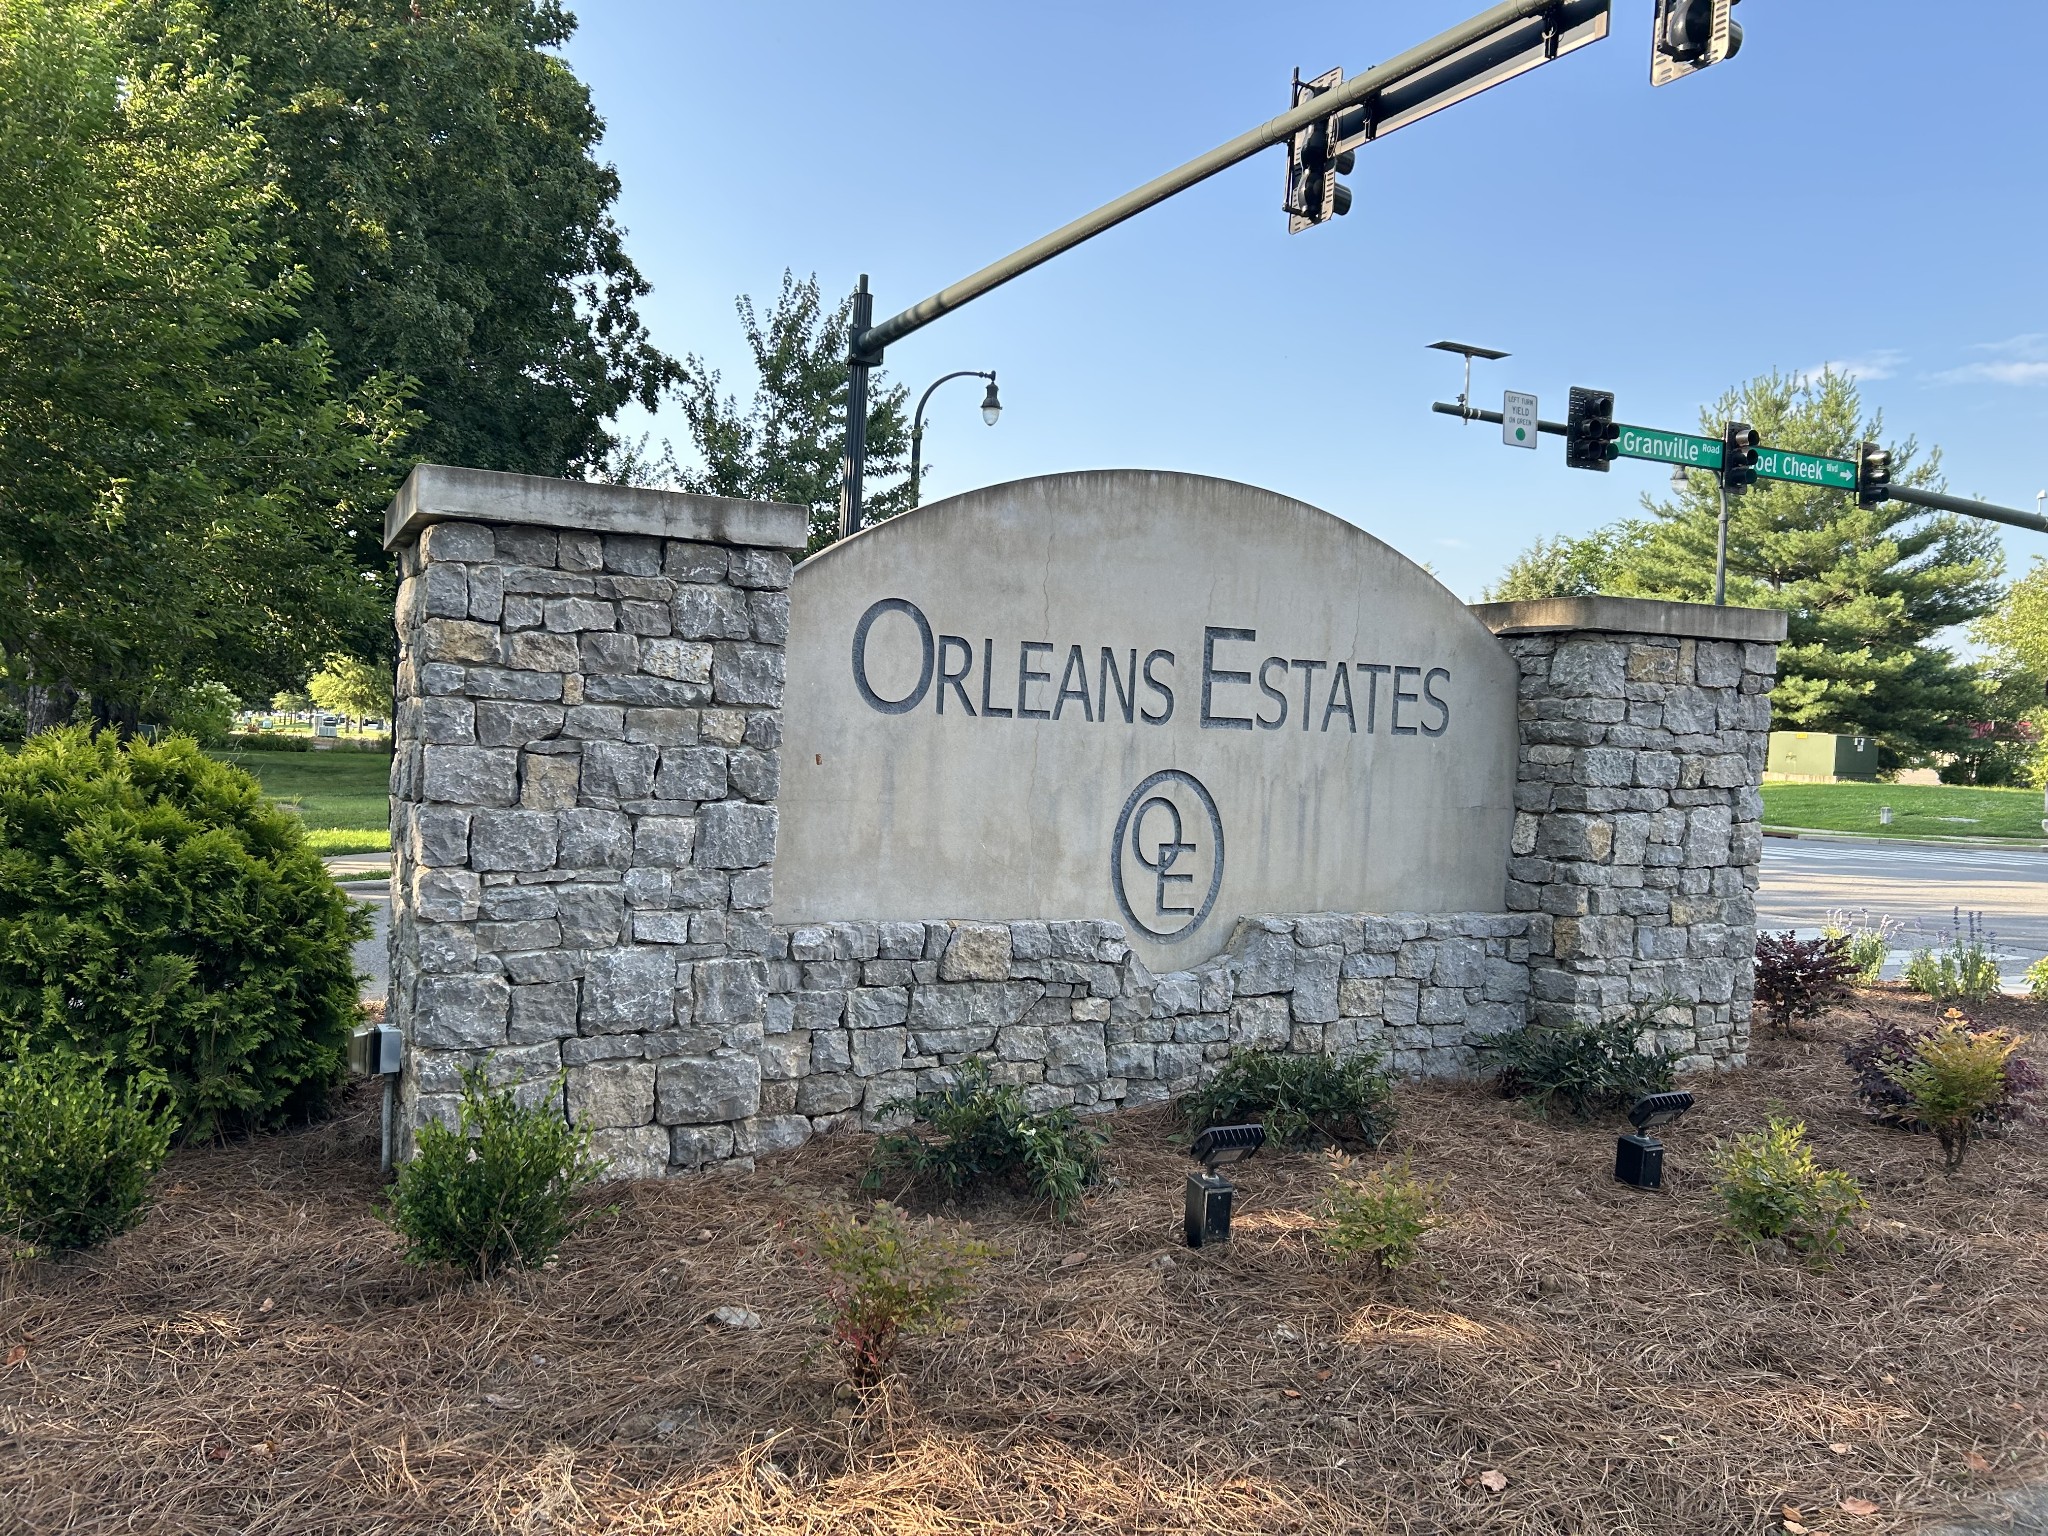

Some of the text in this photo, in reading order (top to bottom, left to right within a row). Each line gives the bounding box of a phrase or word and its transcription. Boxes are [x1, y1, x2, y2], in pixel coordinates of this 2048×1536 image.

[1512, 406, 1530, 416] YIELD
[1521, 398, 1533, 406] TURN
[1623, 431, 1720, 461] Granville Road
[1749, 453, 1839, 480] oel Cheek Blvd
[851, 597, 1452, 738] ORLEANS ESTATES
